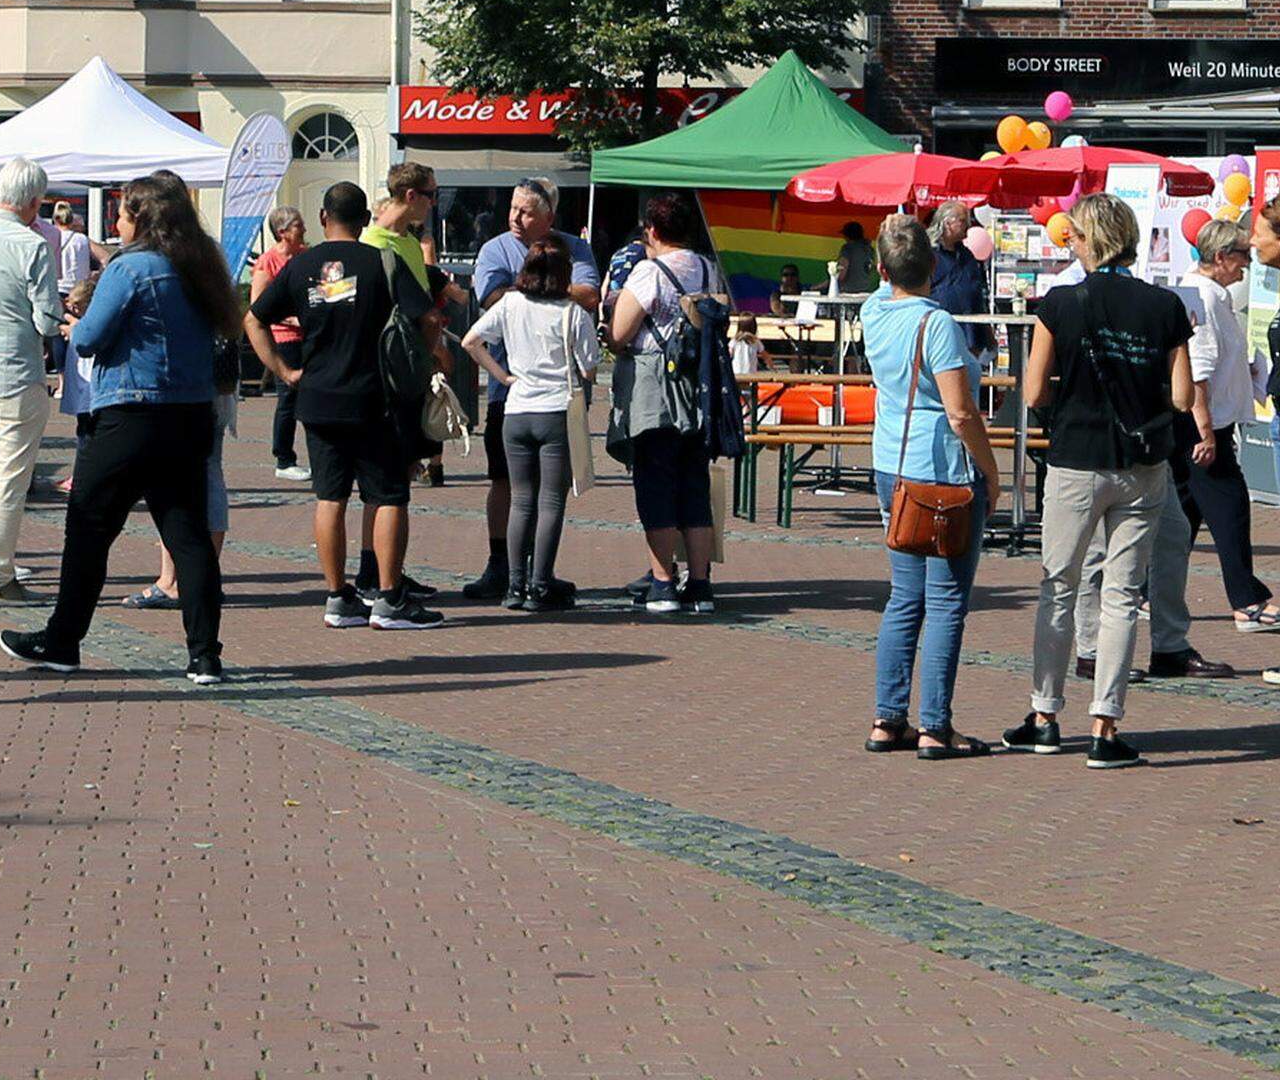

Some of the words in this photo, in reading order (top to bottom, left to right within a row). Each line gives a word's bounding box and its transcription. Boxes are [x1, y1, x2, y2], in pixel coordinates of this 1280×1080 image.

[1007, 57, 1050, 72] BODY
[1054, 58, 1102, 72] STREET
[1169, 62, 1201, 78] Weil
[1206, 62, 1226, 78] 20
[403, 99, 494, 120] Mode
[506, 101, 529, 120] &
